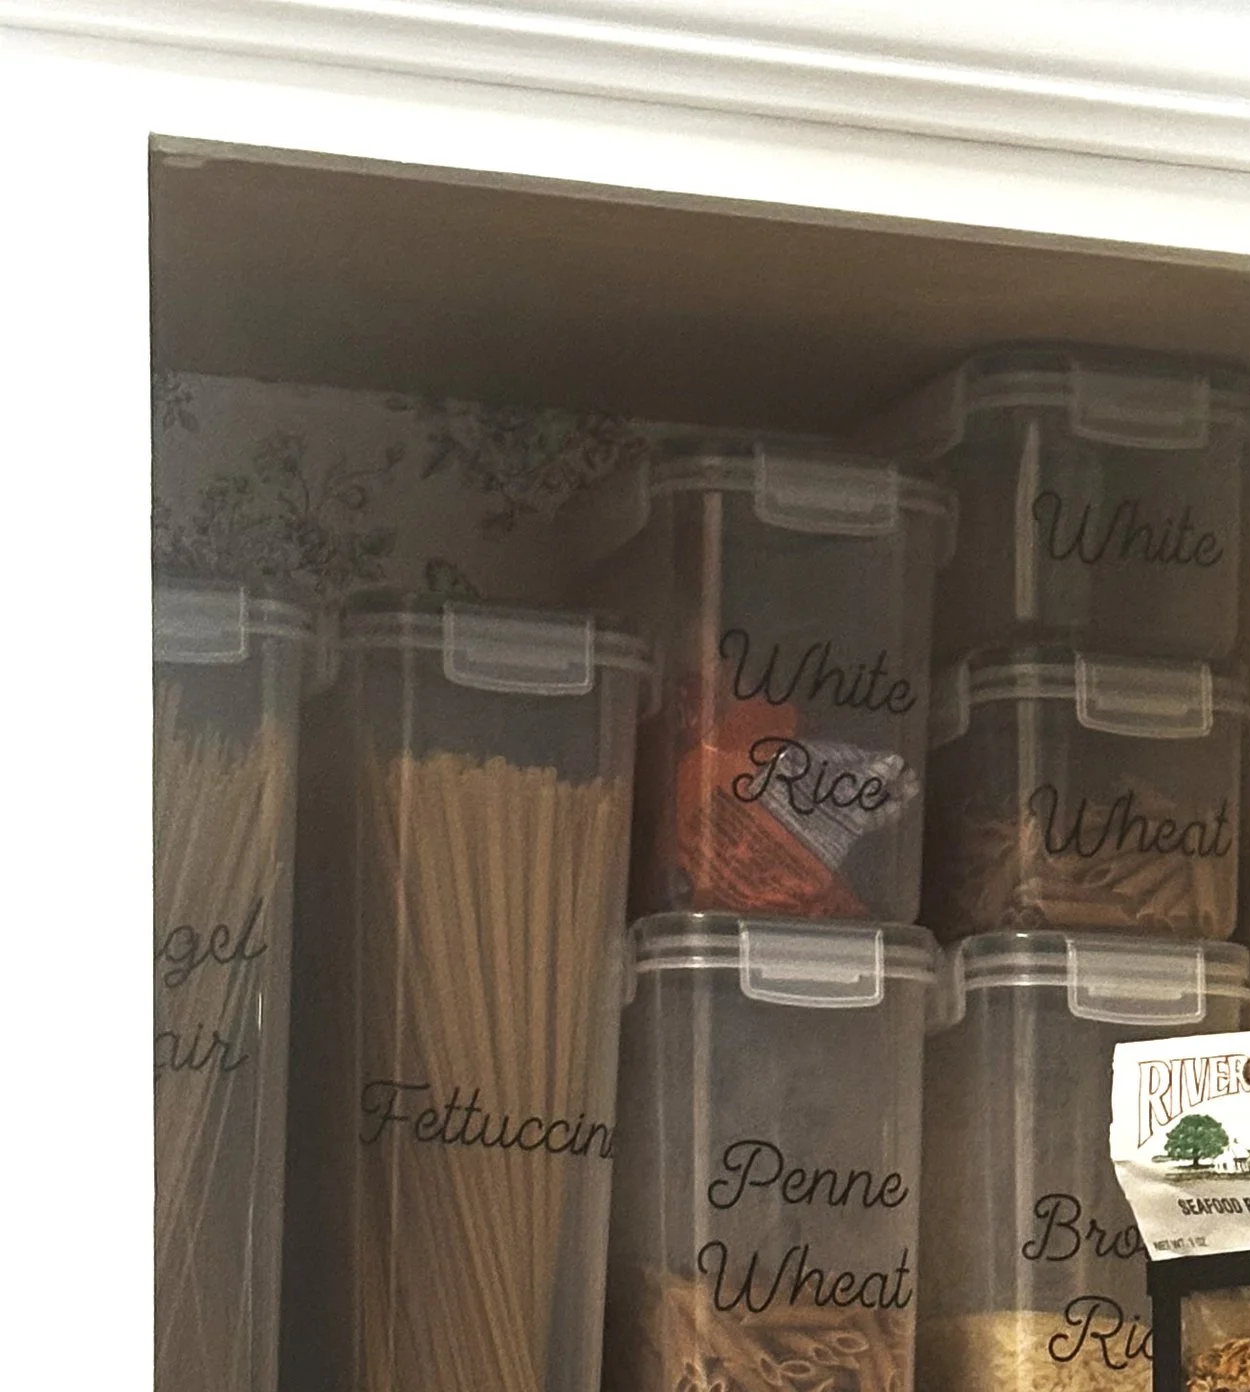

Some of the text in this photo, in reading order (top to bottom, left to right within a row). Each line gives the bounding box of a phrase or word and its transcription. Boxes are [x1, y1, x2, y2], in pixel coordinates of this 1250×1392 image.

[1031, 491, 1224, 567] White
[719, 629, 917, 715] White
[732, 738, 890, 816] Rice
[1029, 783, 1233, 860] Wheat
[153, 896, 267, 987] gel
[153, 1018, 248, 1074] air
[358, 1080, 615, 1160] Fettuccin
[1138, 1053, 1250, 1148] RIVER
[708, 1139, 909, 1210] Penne
[1178, 1197, 1242, 1215] SEAFOOD
[1021, 1194, 1146, 1262] Bro
[1153, 1240, 1169, 1250] NET
[697, 1240, 913, 1315] Wheat
[1048, 1295, 1153, 1370] Ric
